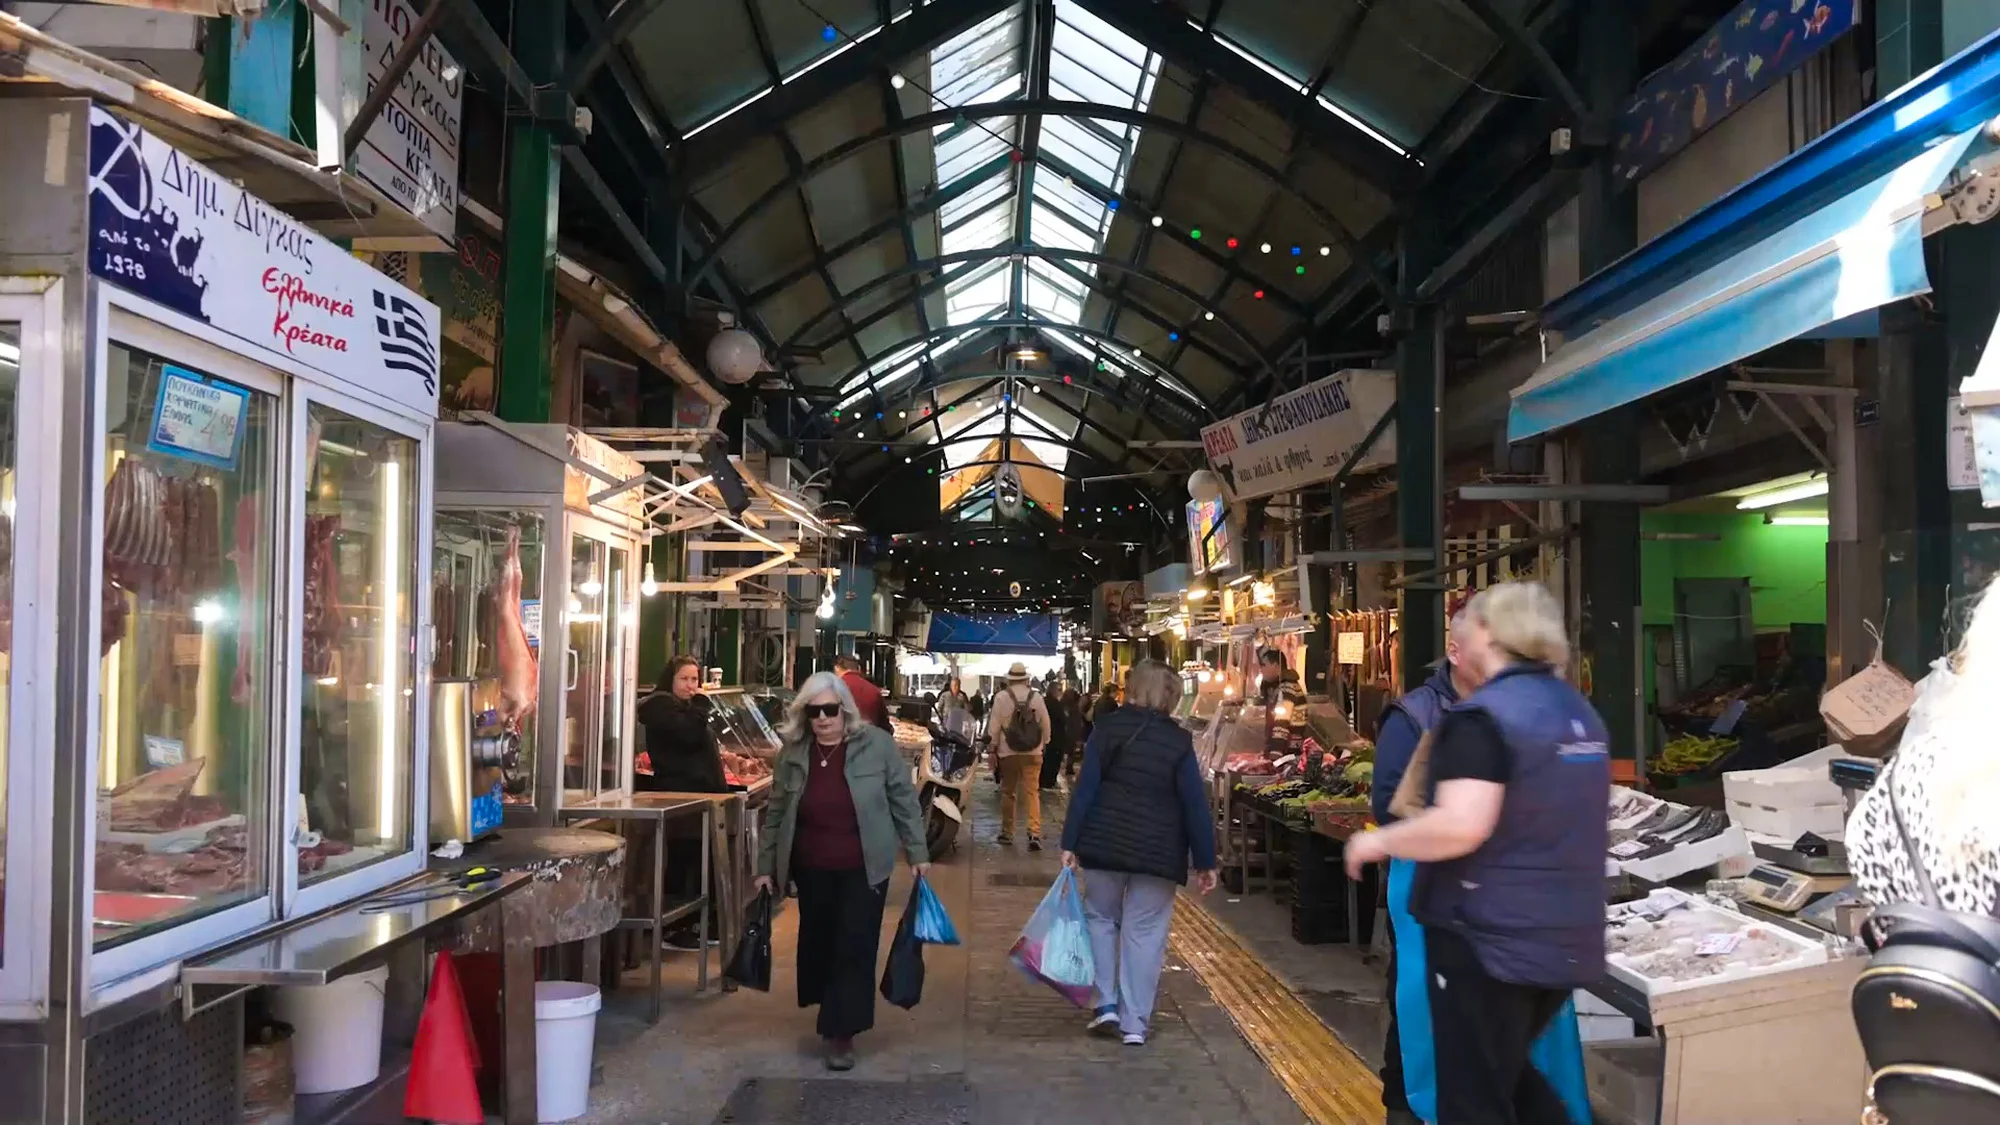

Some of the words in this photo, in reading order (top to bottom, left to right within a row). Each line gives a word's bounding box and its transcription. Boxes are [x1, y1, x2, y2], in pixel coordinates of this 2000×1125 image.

[161, 149, 225, 219] Δημ.
[391, 176, 406, 194] ΑΠΟ
[105, 252, 146, 280] 1978
[261, 267, 355, 317] Ελληνικά
[273, 310, 349, 357] Κρέατα
[1203, 424, 1238, 459] ΚΡΕΑΤΑ
